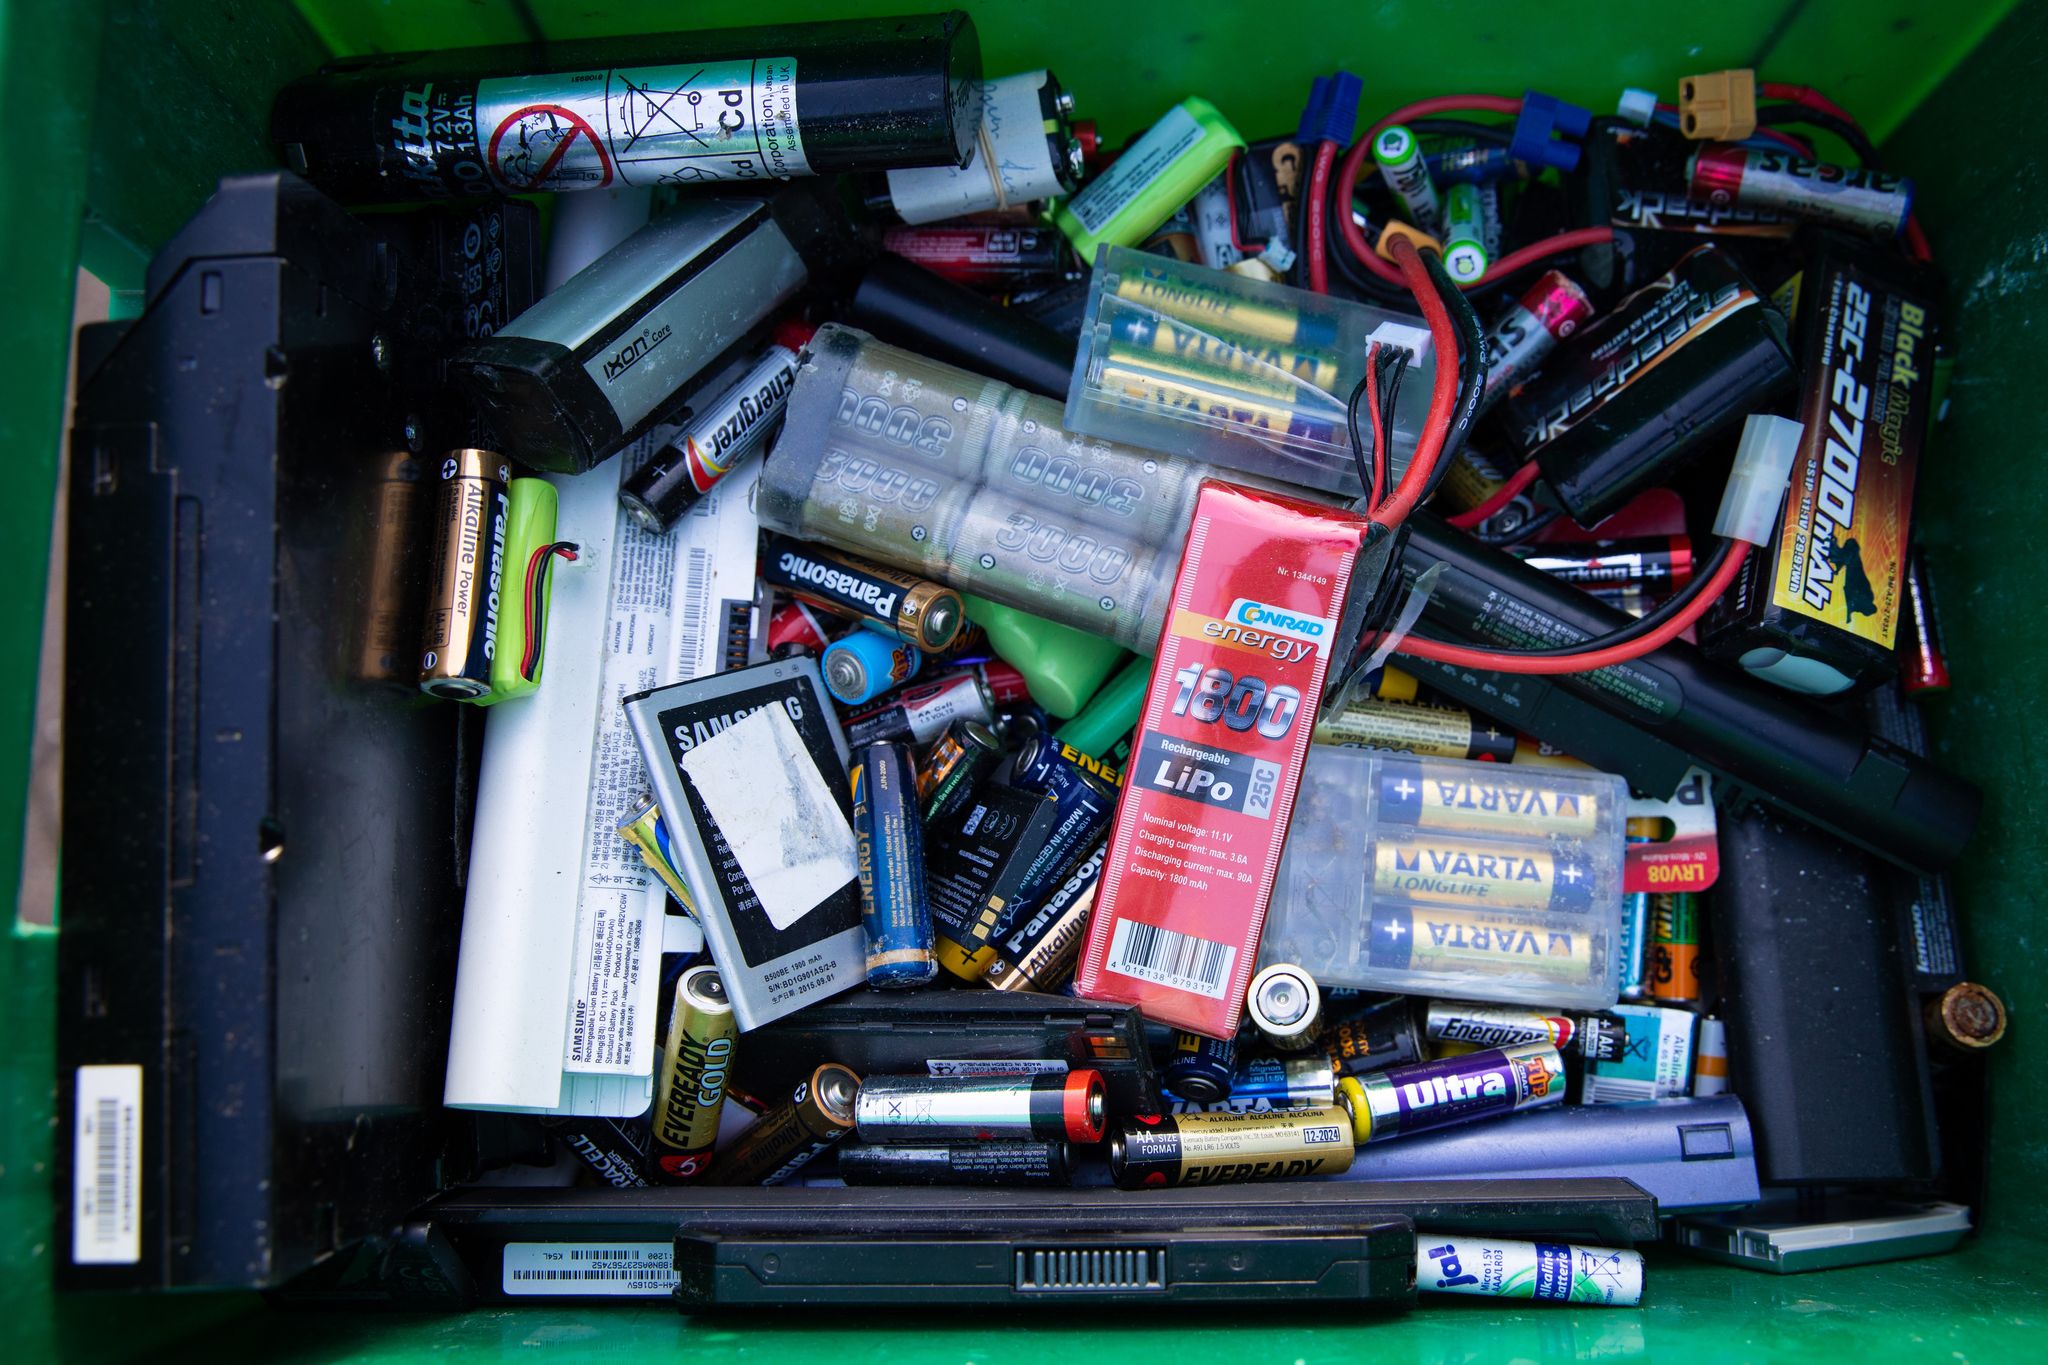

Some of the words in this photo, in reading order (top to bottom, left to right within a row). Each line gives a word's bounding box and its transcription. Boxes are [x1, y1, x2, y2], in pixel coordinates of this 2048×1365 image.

[431, 106, 454, 152] 7.2V
[452, 94, 475, 150] 1.3Ah
[720, 88, 744, 133] Cd
[731, 159, 757, 178] Cd
[1888, 299, 1928, 388] Black
[697, 362, 806, 461] Energizer
[1872, 383, 1912, 467] Magic
[1006, 440, 1149, 521] 3000
[460, 482, 486, 566] Alkaline
[990, 507, 1134, 590] 3000
[455, 569, 474, 618] Power
[481, 492, 511, 661] Panasonic
[771, 549, 900, 619] Panasonic
[1276, 565, 1290, 577] Nr.
[1291, 569, 1327, 586] 1344149
[1235, 598, 1326, 643] CONRAD
[1202, 618, 1315, 664] energy
[1171, 661, 1301, 740] 1800
[1159, 738, 1232, 768] Rechargeable
[1152, 757, 1237, 804] LiPo
[1246, 766, 1276, 811] 25C
[1439, 780, 1552, 817] VARTA
[1047, 831, 1063, 847] IN
[1056, 803, 1085, 838] MADE
[1142, 811, 1176, 829] Nominal
[1175, 821, 1210, 840] voltage:
[1209, 828, 1233, 843] 11.1V
[1133, 844, 1183, 868] Discharging
[1183, 858, 1216, 875] current:
[1215, 867, 1236, 880] max.
[1236, 871, 1254, 885] 90A
[1137, 827, 1176, 849] Charging
[1175, 839, 1208, 855] current:
[1207, 847, 1229, 861] max.
[1229, 852, 1249, 866] 3.6A
[1128, 861, 1168, 883] Capacity:
[1167, 872, 1189, 887] 1800
[1187, 877, 1210, 892] mAh
[1425, 846, 1545, 886] VARTA
[1645, 860, 1705, 884] LRV08
[1392, 873, 1493, 899] LONGLIFE
[626, 919, 635, 938] China
[1023, 901, 1091, 978] Alkaline
[1424, 919, 1544, 958] VARTA
[1910, 903, 1932, 974] lenovo
[612, 951, 622, 978] Product
[762, 965, 790, 983] B500BE
[790, 959, 807, 972] 1900
[806, 953, 823, 965] mAh
[796, 972, 836, 994] 2015.09.01
[1110, 960, 1117, 968] 4
[1123, 963, 1165, 982] 016138
[1171, 976, 1213, 994] 979312
[1654, 945, 1673, 984] GP
[599, 1009, 608, 1021] DC
[600, 988, 609, 1008] 11.1V
[610, 988, 619, 1006] Pack
[570, 998, 587, 1061] SAMSUNG
[584, 1016, 596, 1062] Rechargeable
[590, 971, 601, 996] Battery
[607, 1007, 619, 1032] Battery
[617, 1026, 626, 1040] cells
[618, 1008, 627, 1025] made
[1437, 1015, 1547, 1052] Energizer
[605, 1032, 616, 1063] Standard
[615, 1041, 625, 1064] Battery
[659, 1028, 712, 1147] EVEREADY
[694, 1033, 734, 1110] GOLD
[1248, 1064, 1281, 1075] Mignon
[1402, 1066, 1508, 1111] Ultra
[1209, 1112, 1245, 1122] ALKALINE
[1249, 1110, 1284, 1120] ALCALINE
[1288, 1108, 1324, 1118] ALCALINA
[1135, 1129, 1154, 1145] AA
[1157, 1133, 1178, 1144] SIZE
[1141, 1143, 1177, 1155] FORMAT
[1306, 1128, 1338, 1143] 12-2024
[605, 1146, 639, 1182] POWER
[1178, 1158, 1325, 1184] EVEREADY
[542, 1252, 563, 1260] K54L
[1425, 1242, 1481, 1291] ja!
[1490, 1248, 1504, 1292] AAA/LR03
[1539, 1249, 1555, 1297] Alkaline
[1554, 1251, 1570, 1298] Batterie
[1479, 1267, 1493, 1292] Micro
